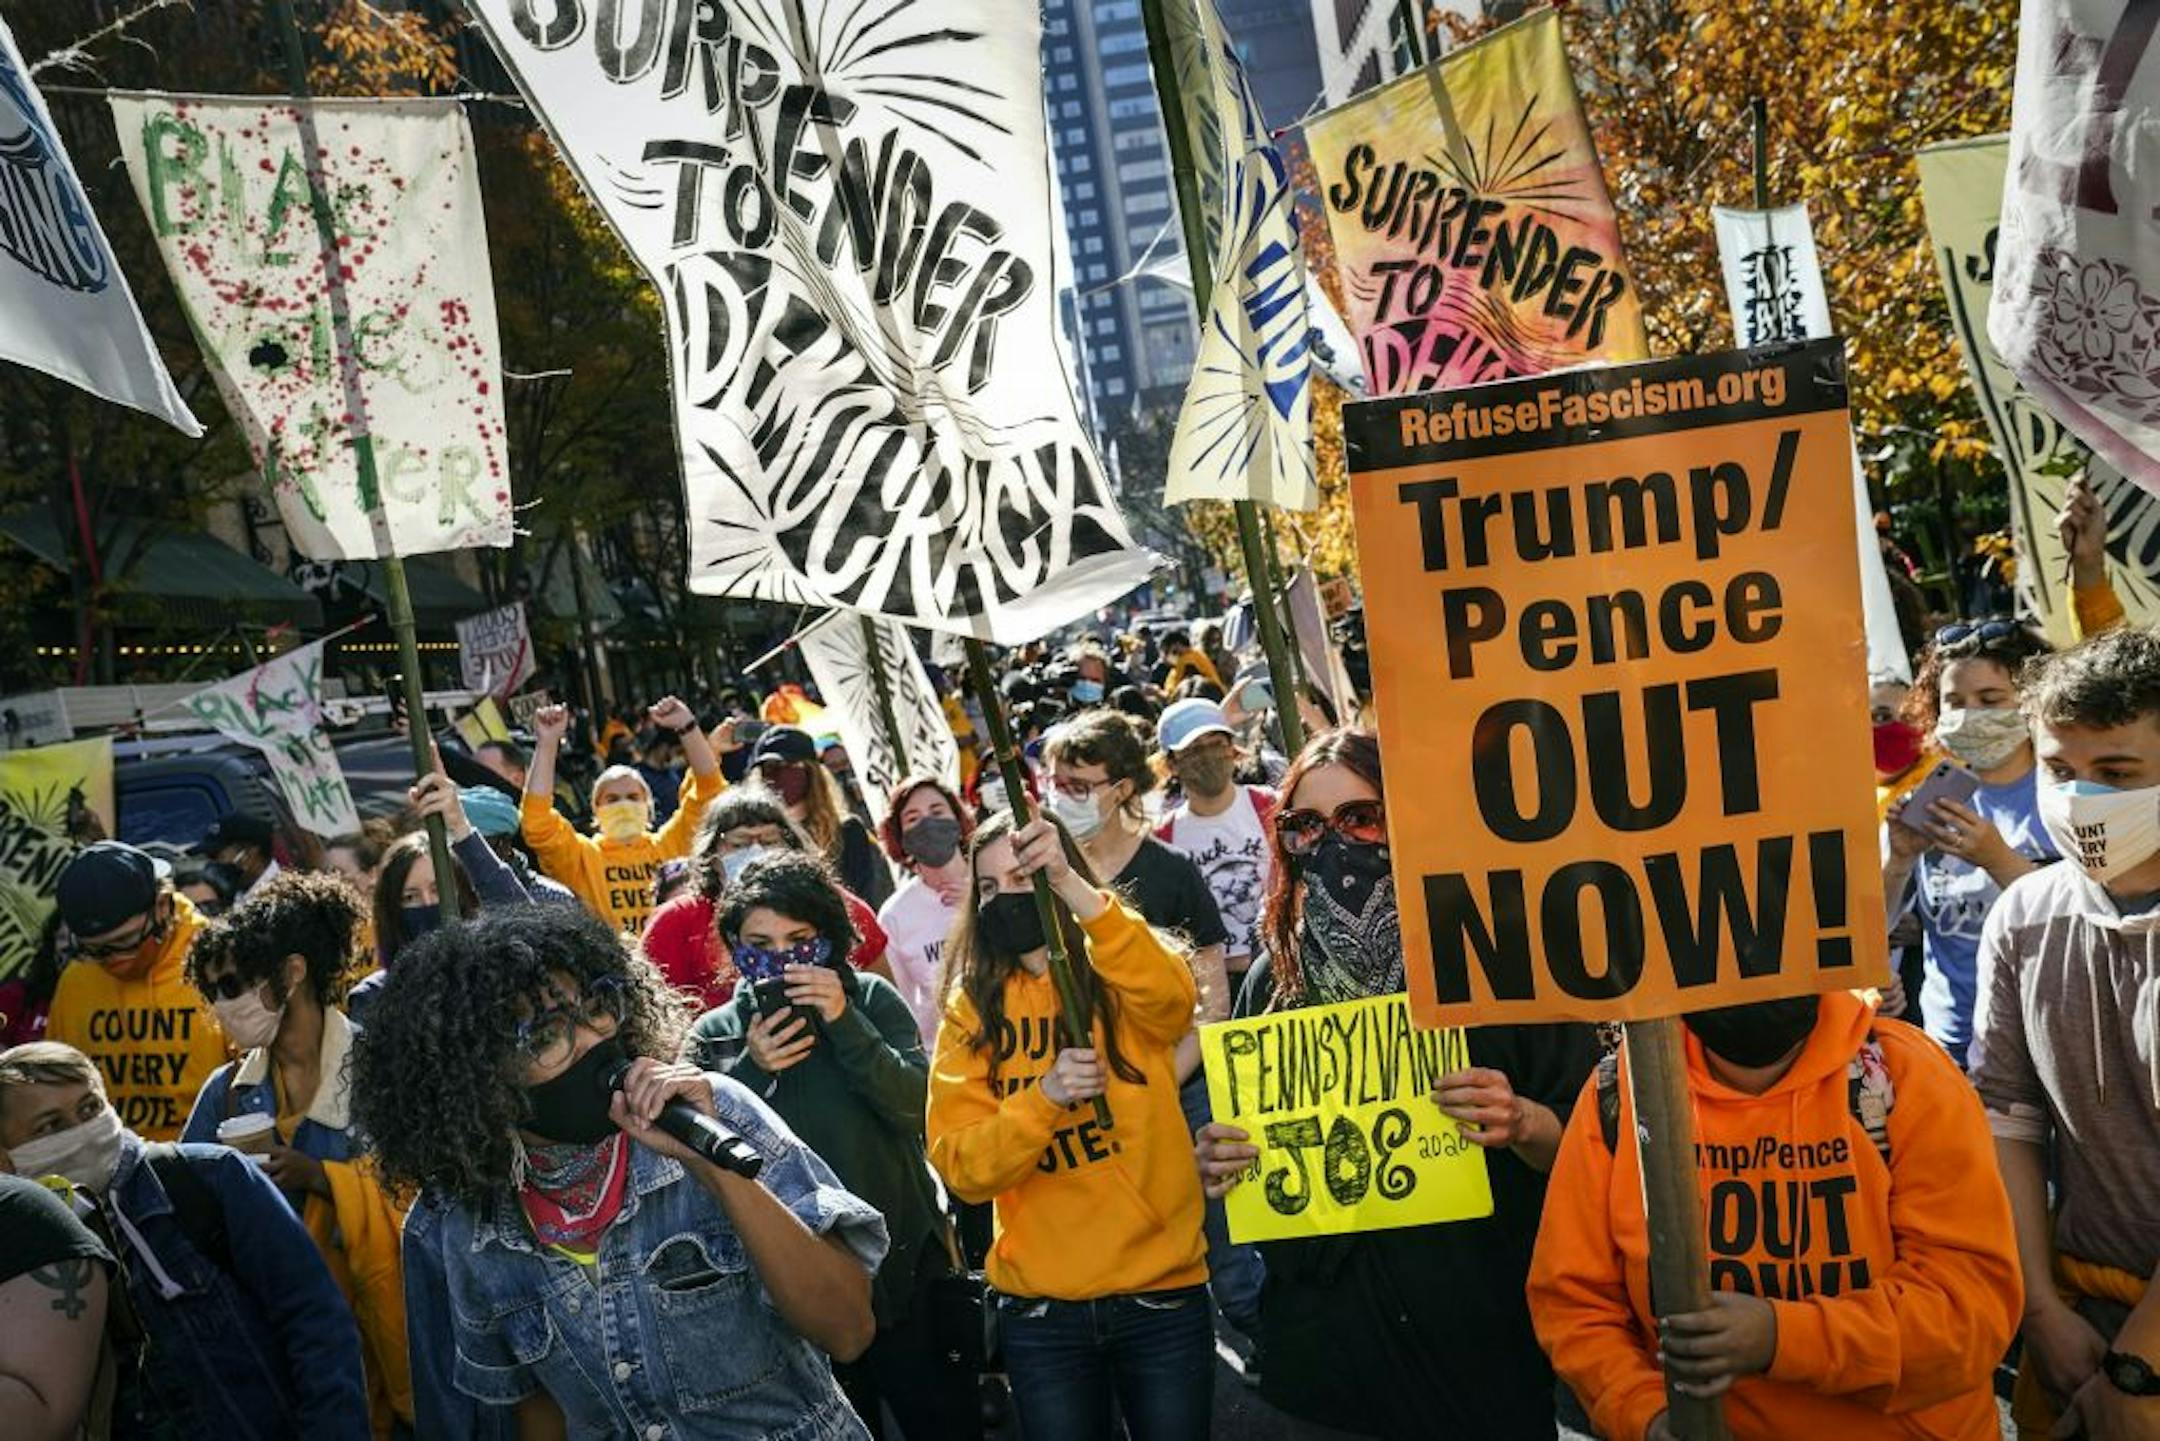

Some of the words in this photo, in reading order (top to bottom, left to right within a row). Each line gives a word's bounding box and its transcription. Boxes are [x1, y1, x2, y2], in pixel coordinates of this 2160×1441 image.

[642, 139, 778, 250] TO
[1328, 142, 1625, 351] SURRENDER
[1370, 258, 1444, 325] TO
[1400, 363, 1787, 447] RefuseFascism.org
[1399, 430, 1801, 572] Trump/
[1440, 569, 1784, 680] Pence
[1471, 668, 1780, 843] OUT
[605, 861, 660, 882] COUN
[611, 888, 653, 909] EVE
[1422, 829, 1854, 1005] NOW!
[90, 1008, 196, 1042] COUNT
[1264, 1108, 1416, 1216] JOE
[1418, 1135, 1469, 1160] 2020
[1709, 1175, 1856, 1260] OUT
